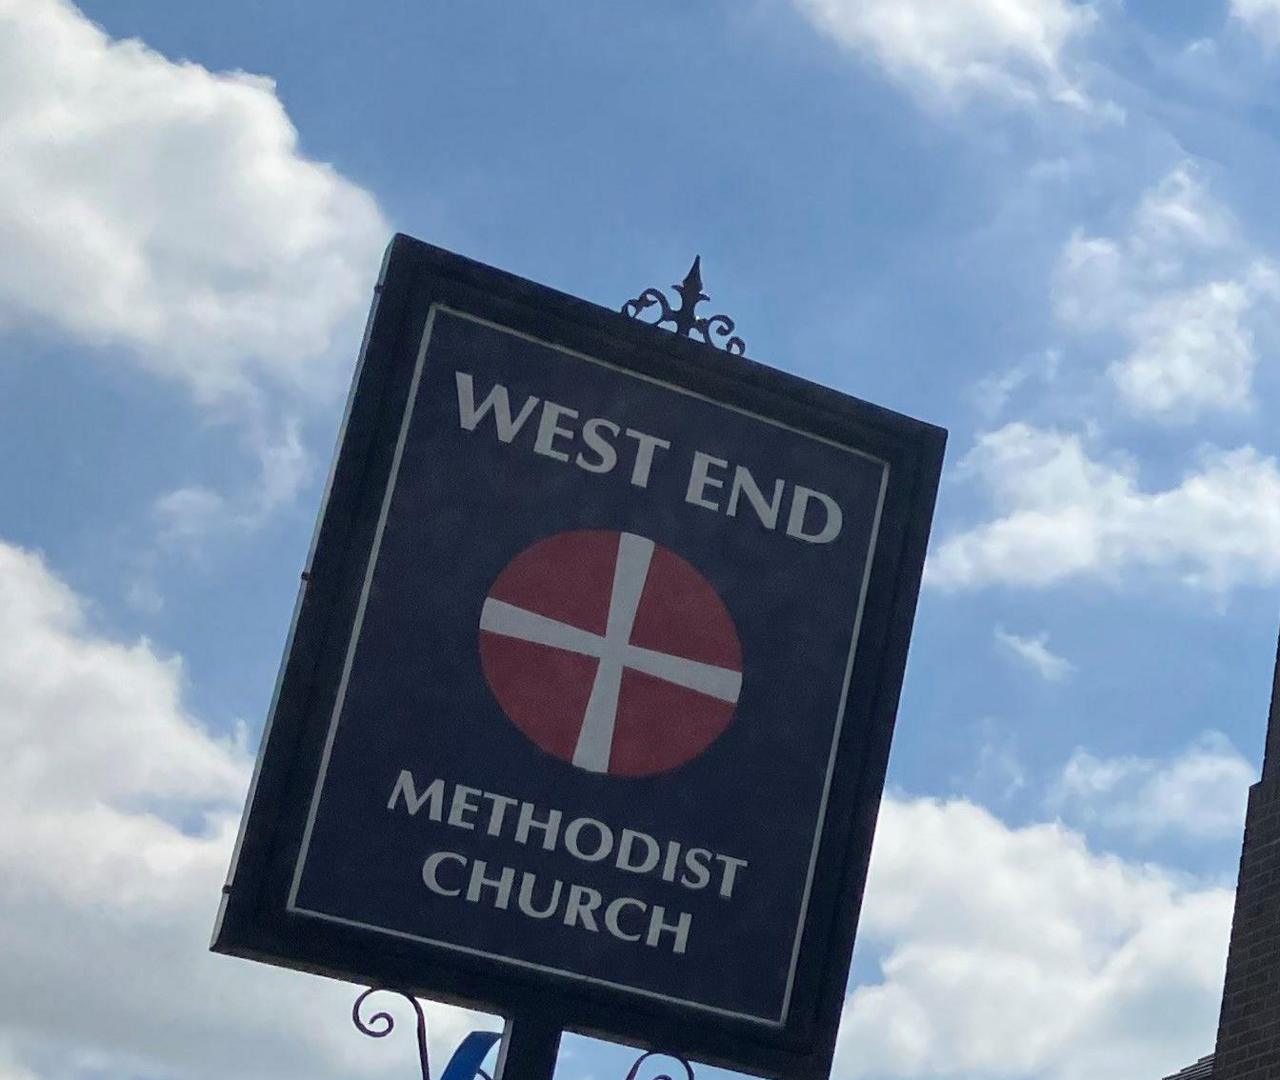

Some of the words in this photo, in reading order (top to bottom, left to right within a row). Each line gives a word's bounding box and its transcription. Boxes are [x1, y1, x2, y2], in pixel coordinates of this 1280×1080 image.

[455, 370, 671, 489] WEST
[685, 450, 843, 545] END
[387, 769, 748, 897] METHODIST
[422, 851, 692, 954] CHURCH
